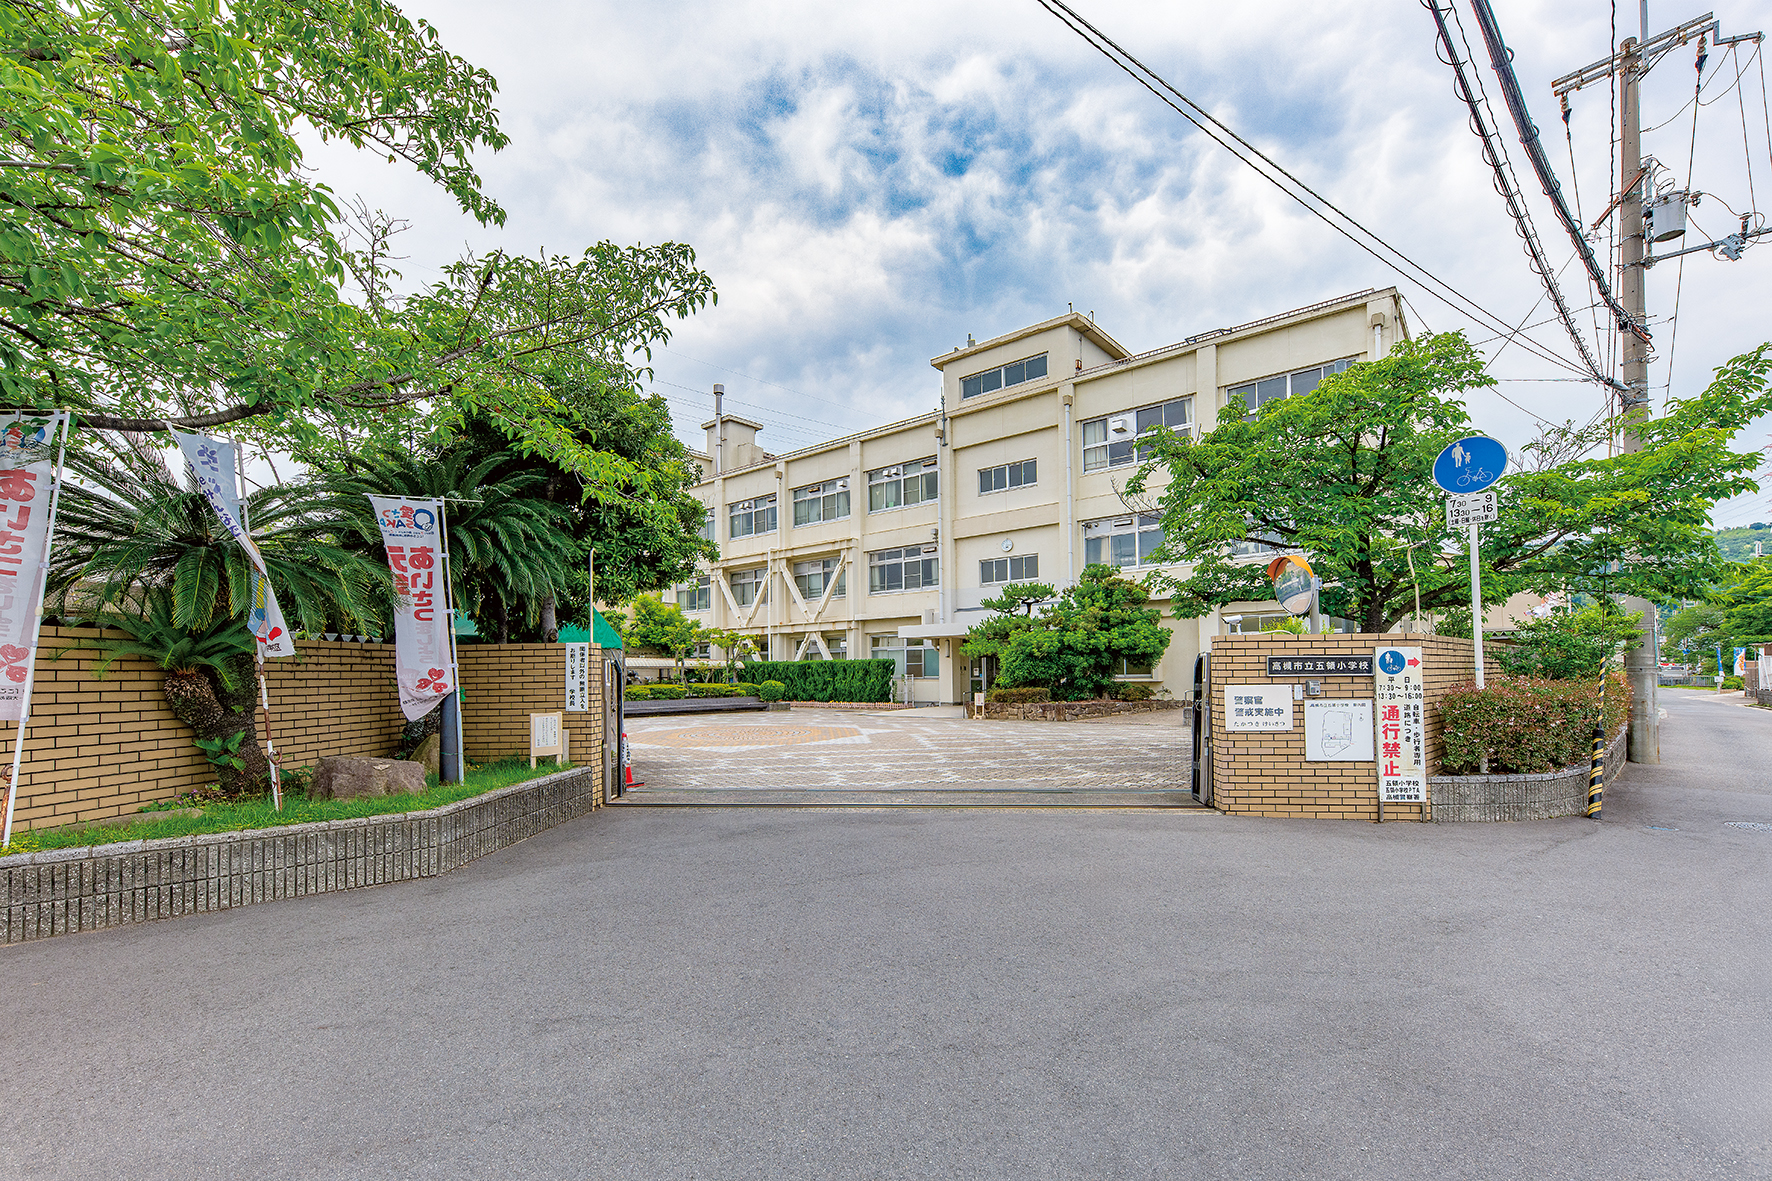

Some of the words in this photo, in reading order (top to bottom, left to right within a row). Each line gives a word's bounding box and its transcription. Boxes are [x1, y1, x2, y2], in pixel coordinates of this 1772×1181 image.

[1485, 494, 1492, 502] 9
[1482, 504, 1493, 513] 16
[1272, 661, 1369, 671] 高槻市立五領小学校
[1234, 695, 1263, 705] 警察官
[1234, 707, 1284, 717] 警戒実施中
[1403, 704, 1411, 743] 道路につき
[1382, 705, 1401, 777] 通行禁止
